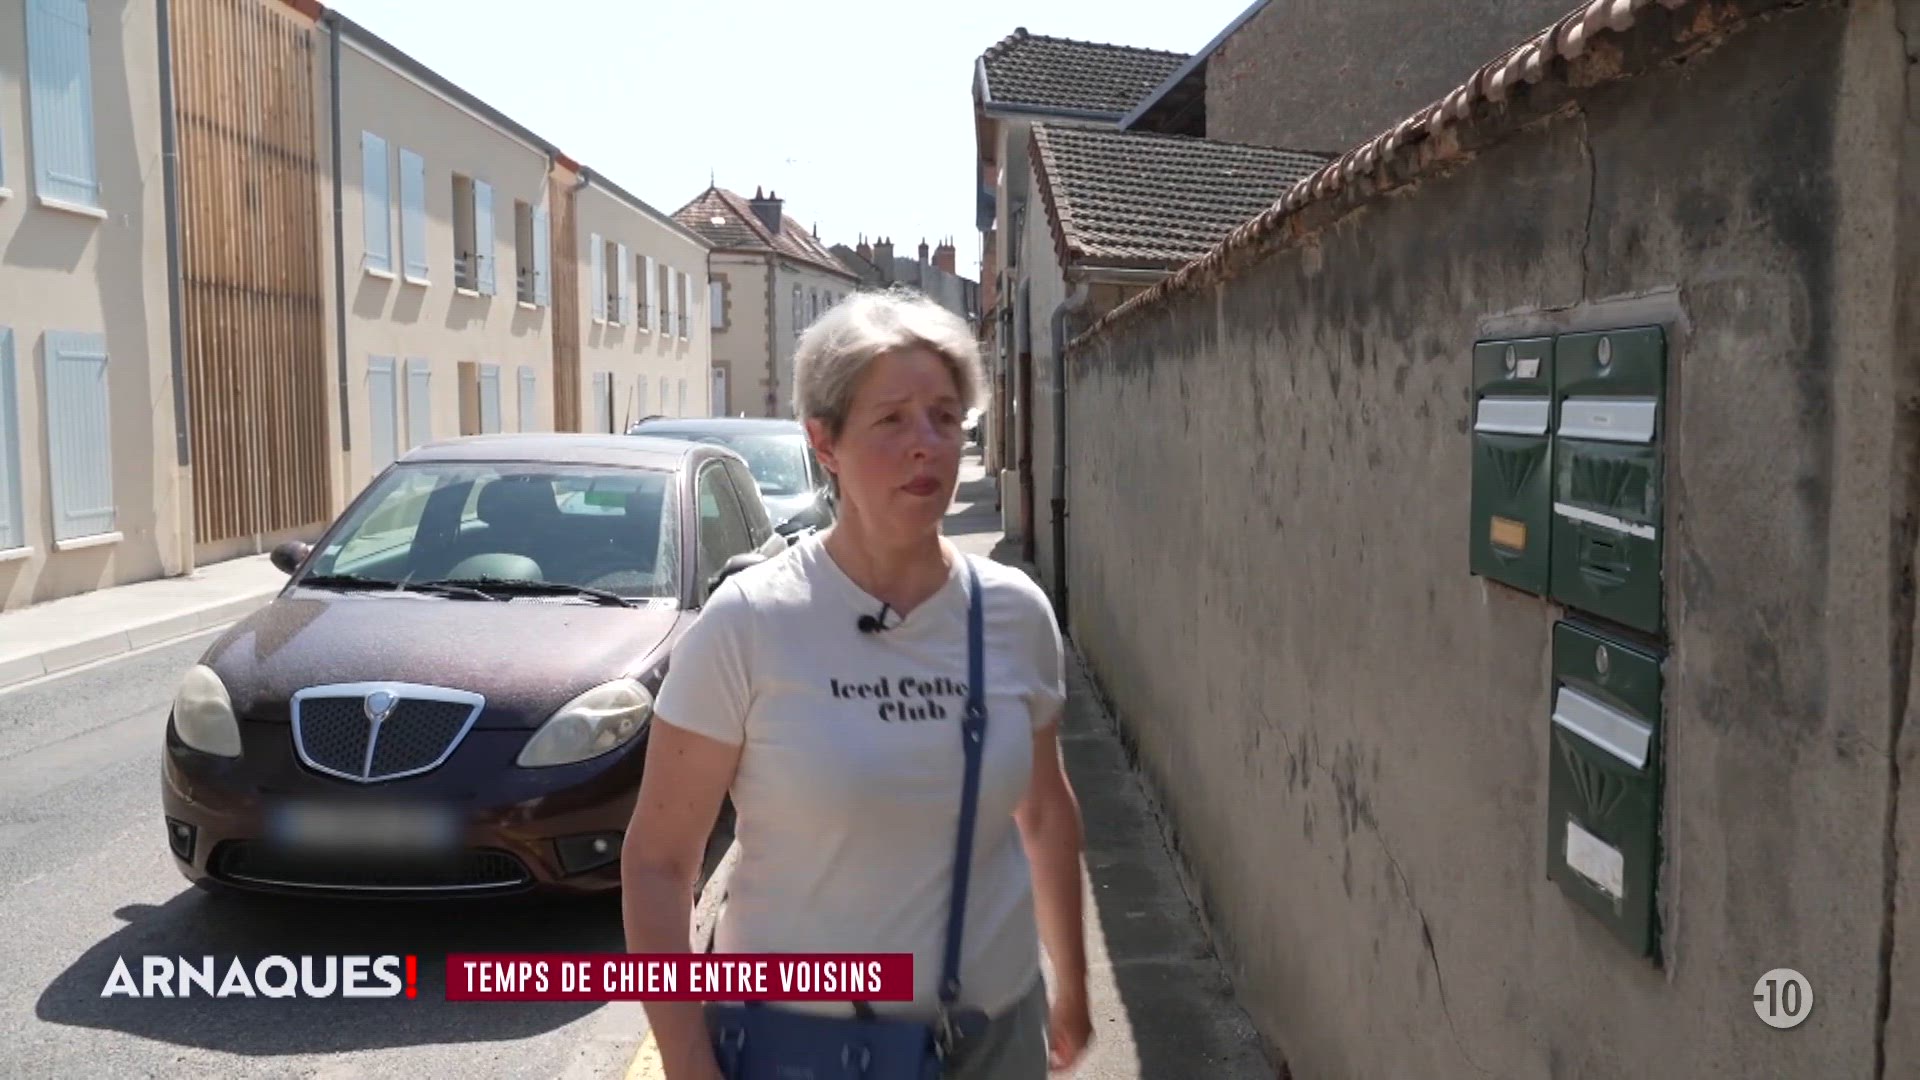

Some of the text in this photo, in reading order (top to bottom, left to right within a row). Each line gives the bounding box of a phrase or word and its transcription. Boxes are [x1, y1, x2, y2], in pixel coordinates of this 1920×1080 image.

[830, 676, 970, 699] Iced Coffe
[878, 700, 947, 721] Club
